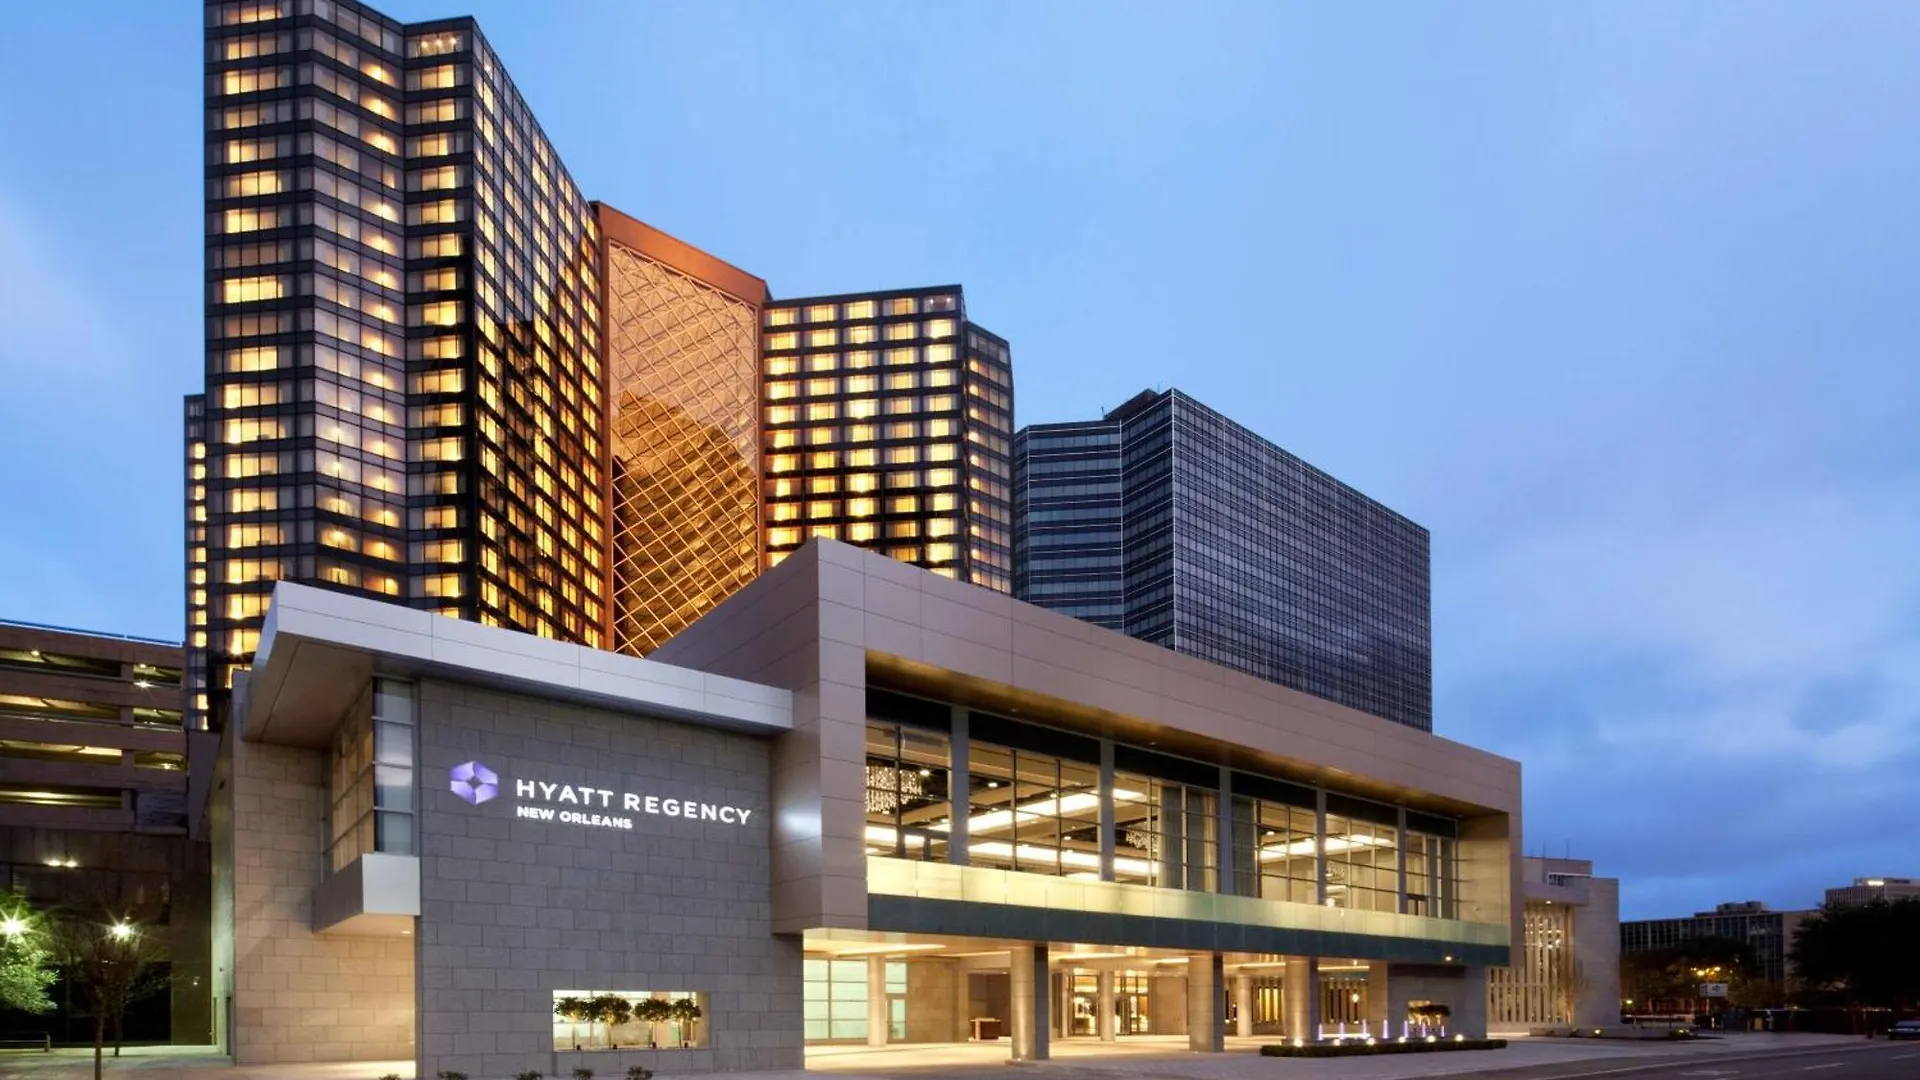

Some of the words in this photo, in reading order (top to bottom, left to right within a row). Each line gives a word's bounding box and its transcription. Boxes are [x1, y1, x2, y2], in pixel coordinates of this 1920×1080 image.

[516, 778, 614, 808] HYATT
[623, 792, 752, 825] REGENCY
[516, 805, 555, 821] NEW
[558, 810, 633, 830] ORLEANS
